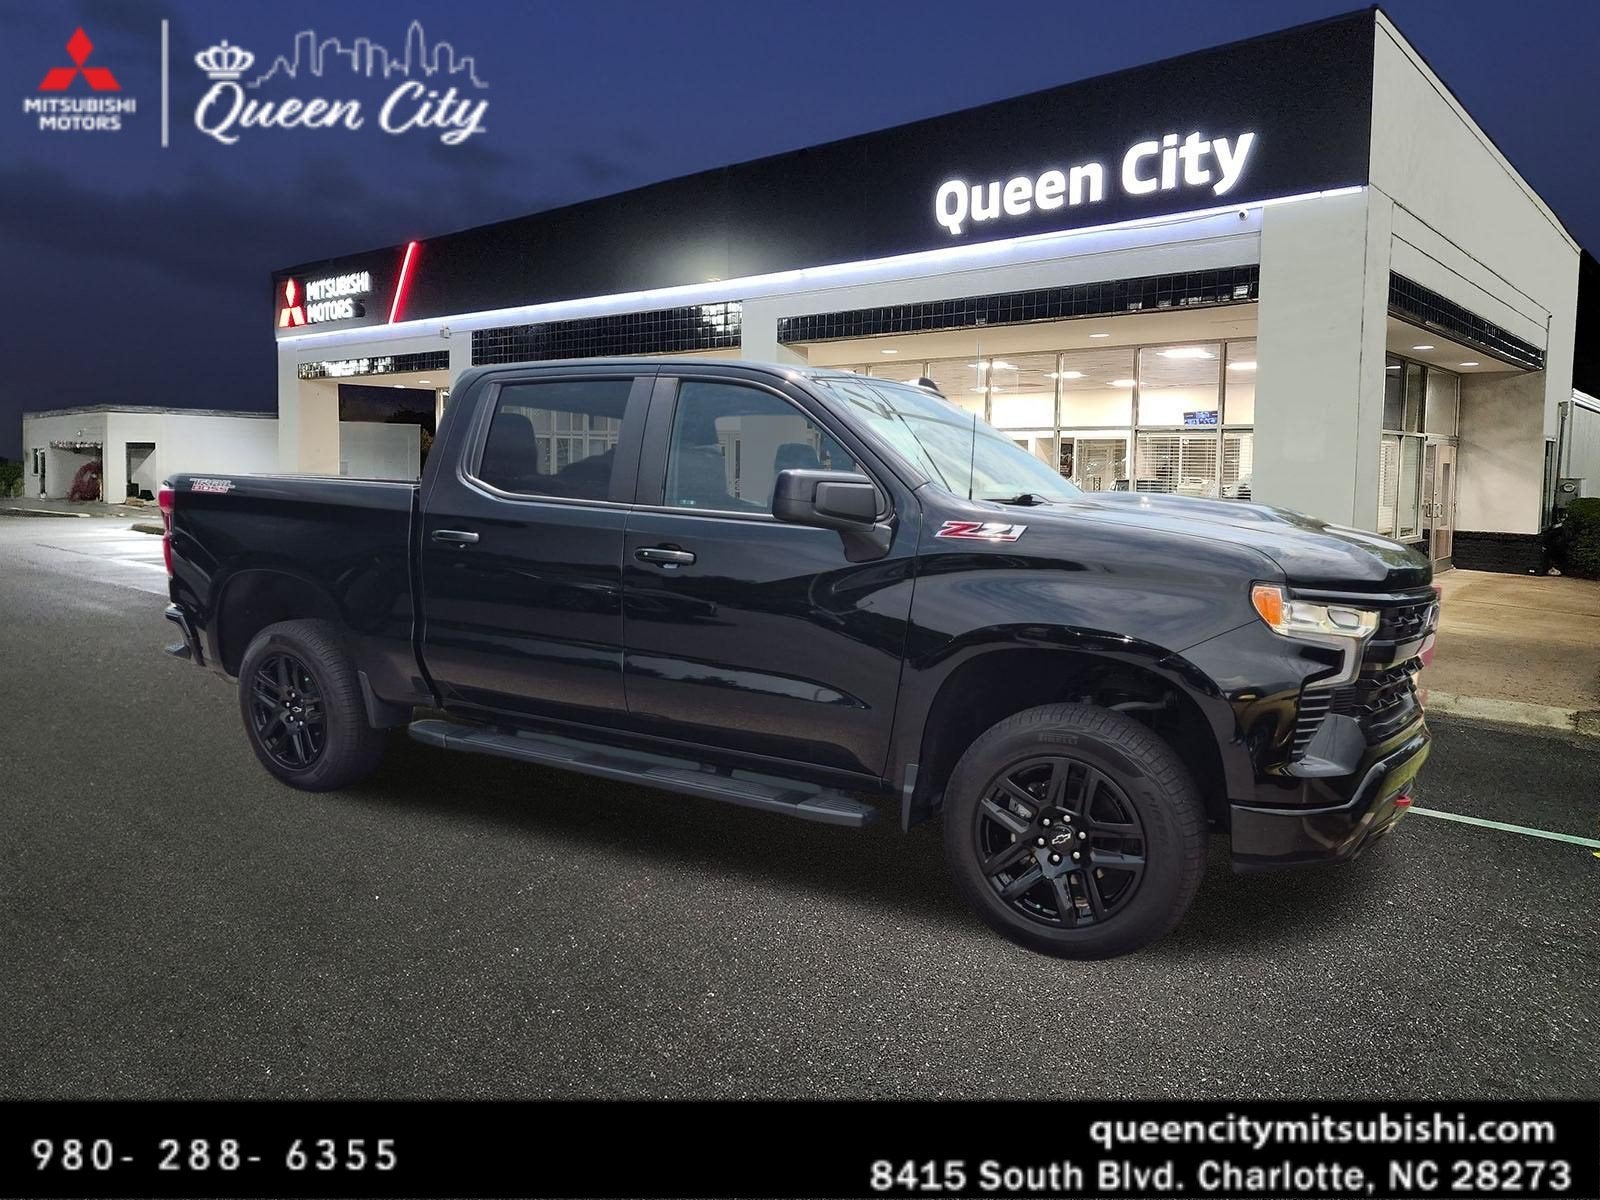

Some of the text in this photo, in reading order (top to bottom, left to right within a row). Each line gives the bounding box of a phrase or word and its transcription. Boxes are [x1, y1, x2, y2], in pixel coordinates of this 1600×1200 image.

[935, 131, 1256, 235] Queen City
[306, 270, 370, 302] MITSUBISHI
[307, 297, 356, 323] MOTORS
[935, 520, 1028, 542] Z71
